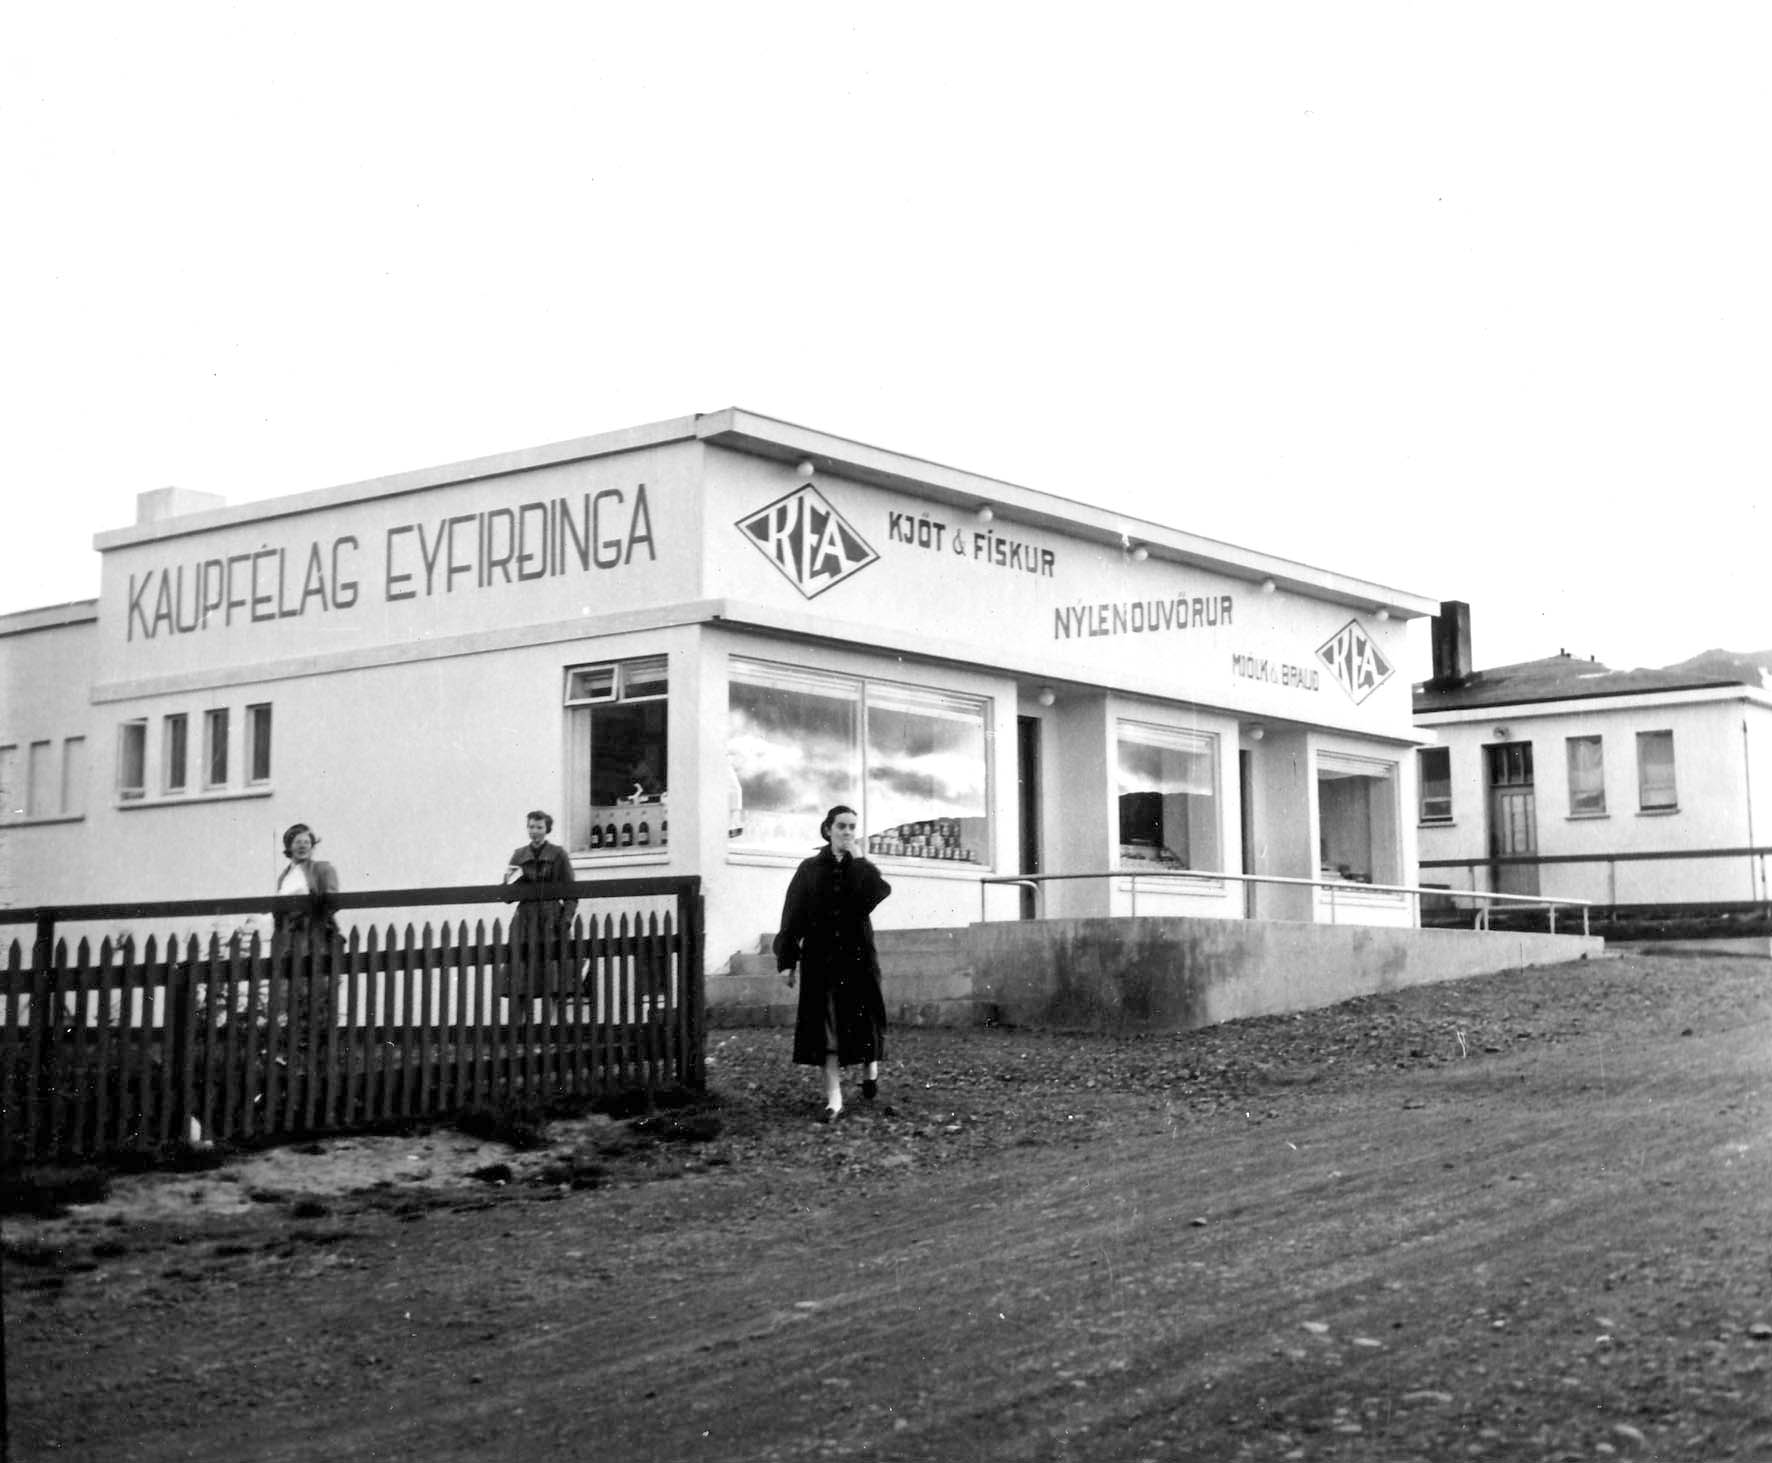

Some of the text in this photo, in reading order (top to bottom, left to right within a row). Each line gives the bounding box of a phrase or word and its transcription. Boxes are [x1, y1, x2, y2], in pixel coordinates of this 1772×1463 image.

[126, 483, 657, 642] KAUPFÉLAG EYFIRÐINGA
[755, 489, 870, 595] KEA
[888, 511, 946, 551] KJÖT
[952, 528, 967, 556] &
[1326, 623, 1388, 699] KEA
